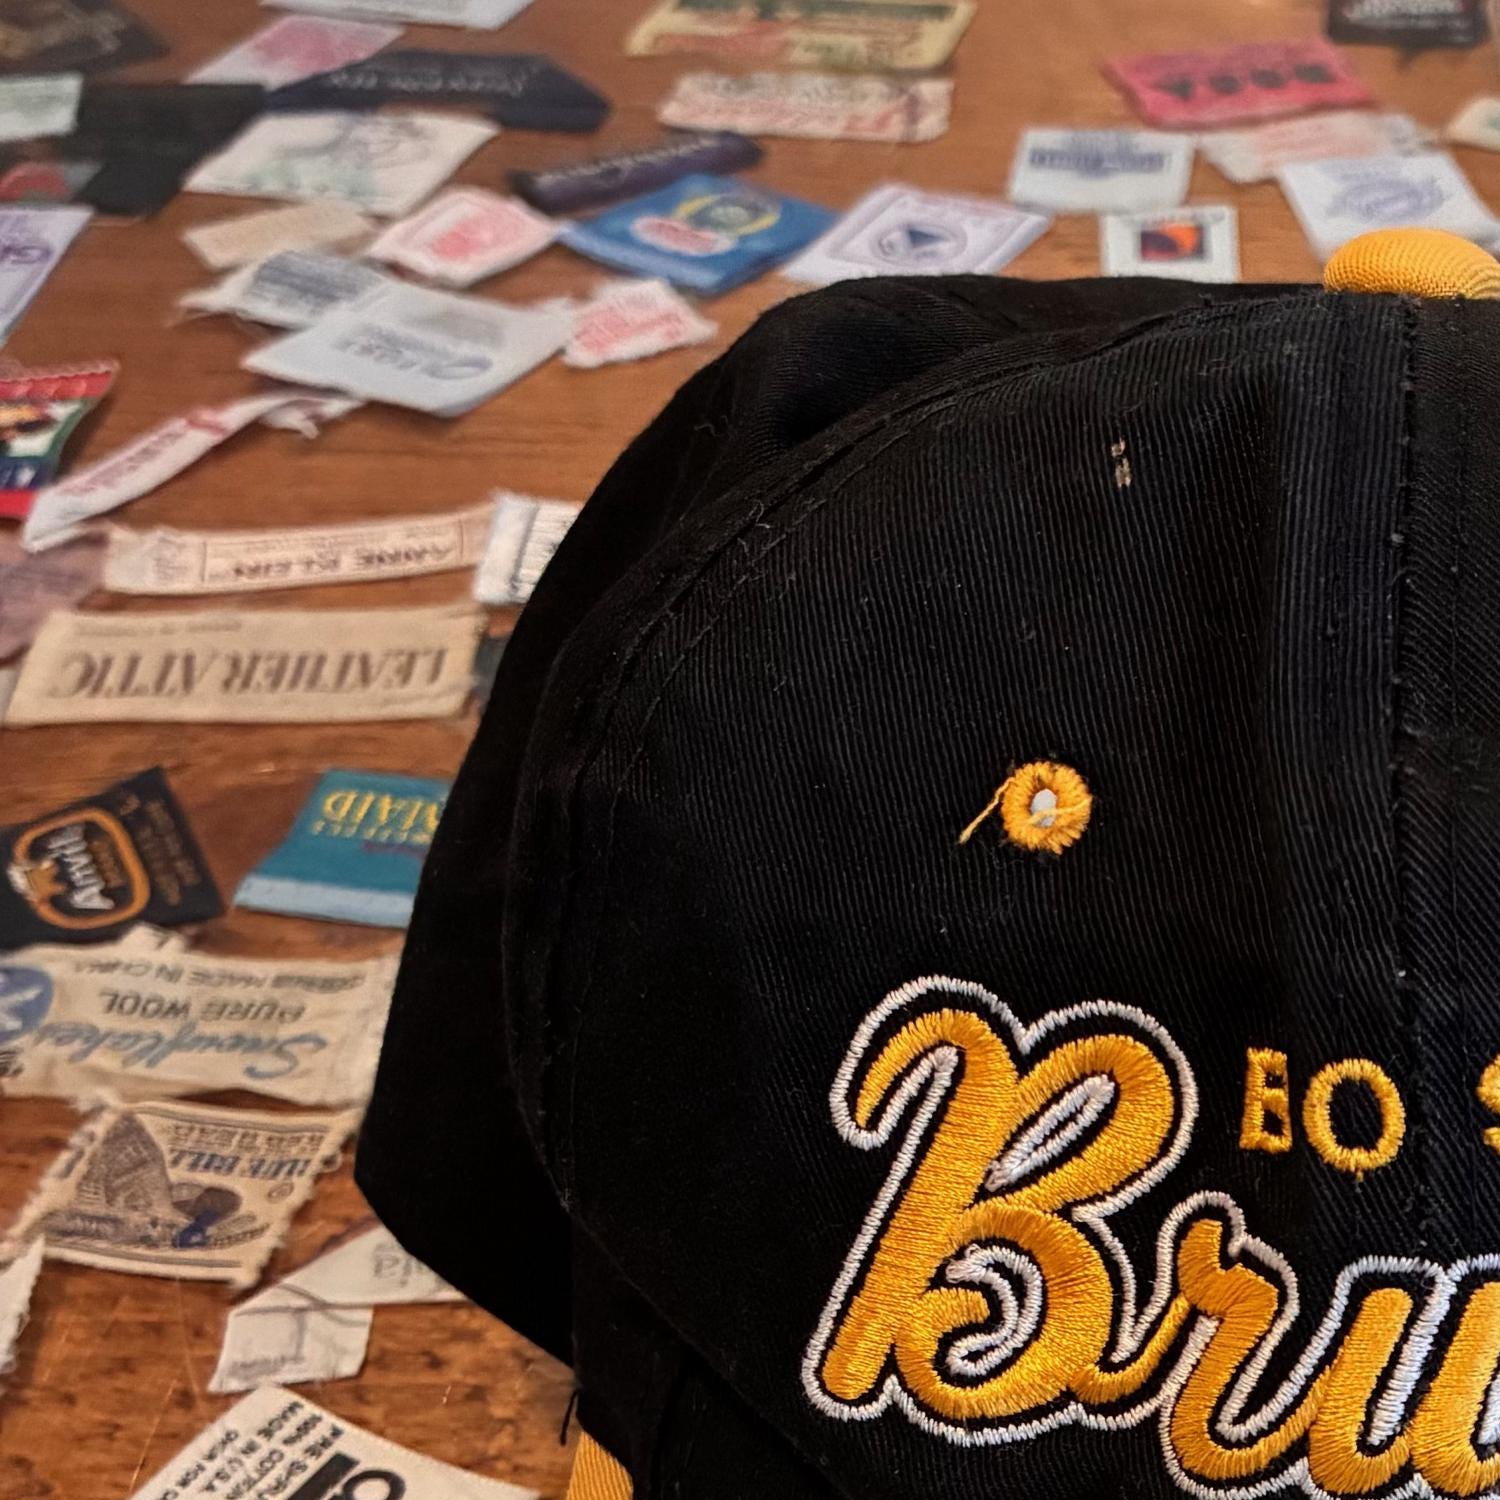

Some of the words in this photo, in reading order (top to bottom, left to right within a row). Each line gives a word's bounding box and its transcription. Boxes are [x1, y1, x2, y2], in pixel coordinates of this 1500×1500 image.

[57, 645, 202, 700] ATTIC
[218, 647, 450, 697] LEATHER
[99, 990, 197, 1022] WOOL
[203, 1000, 308, 1026] PURE
[257, 1400, 303, 1441] MADE
